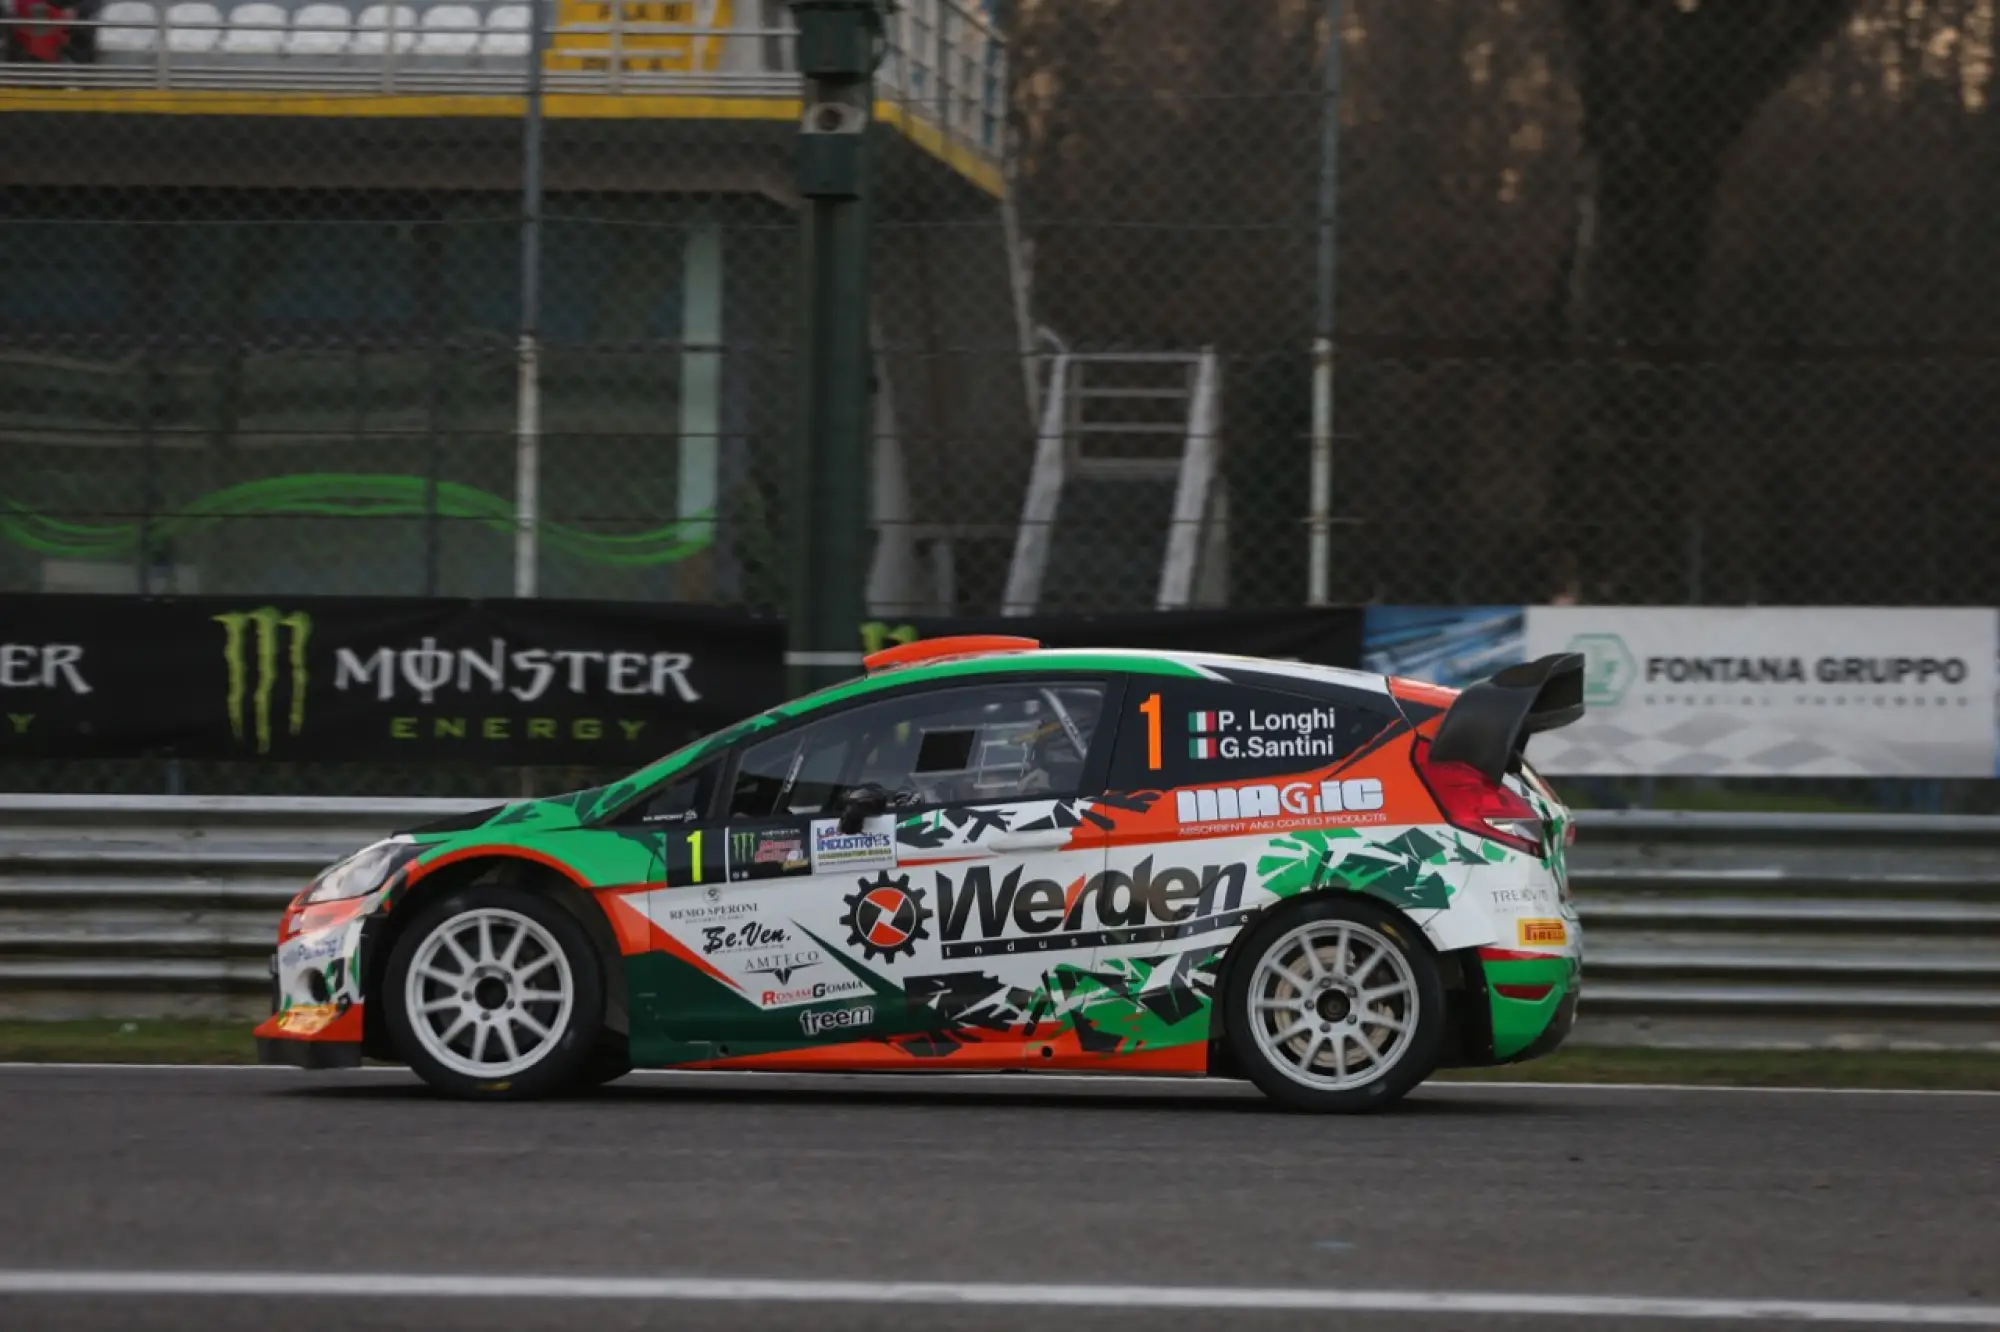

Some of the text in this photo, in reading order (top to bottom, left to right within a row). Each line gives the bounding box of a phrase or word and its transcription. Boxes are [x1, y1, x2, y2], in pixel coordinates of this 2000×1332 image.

[334, 636, 702, 703] MONSTER
[1644, 656, 1970, 686] FONTANA GRUPPO
[390, 716, 647, 741] ENERGY
[1139, 693, 1162, 771] 1
[1217, 707, 1335, 733] P. Longhi
[1219, 734, 1334, 759] G.Santini
[1250, 820, 1274, 830] AND
[1277, 817, 1322, 829] COATED
[1325, 813, 1387, 825] PRODUCTS
[686, 829, 702, 882] 1
[936, 853, 1247, 941] Werden
[744, 949, 820, 970] AMTECO
[800, 1005, 874, 1035] freem
